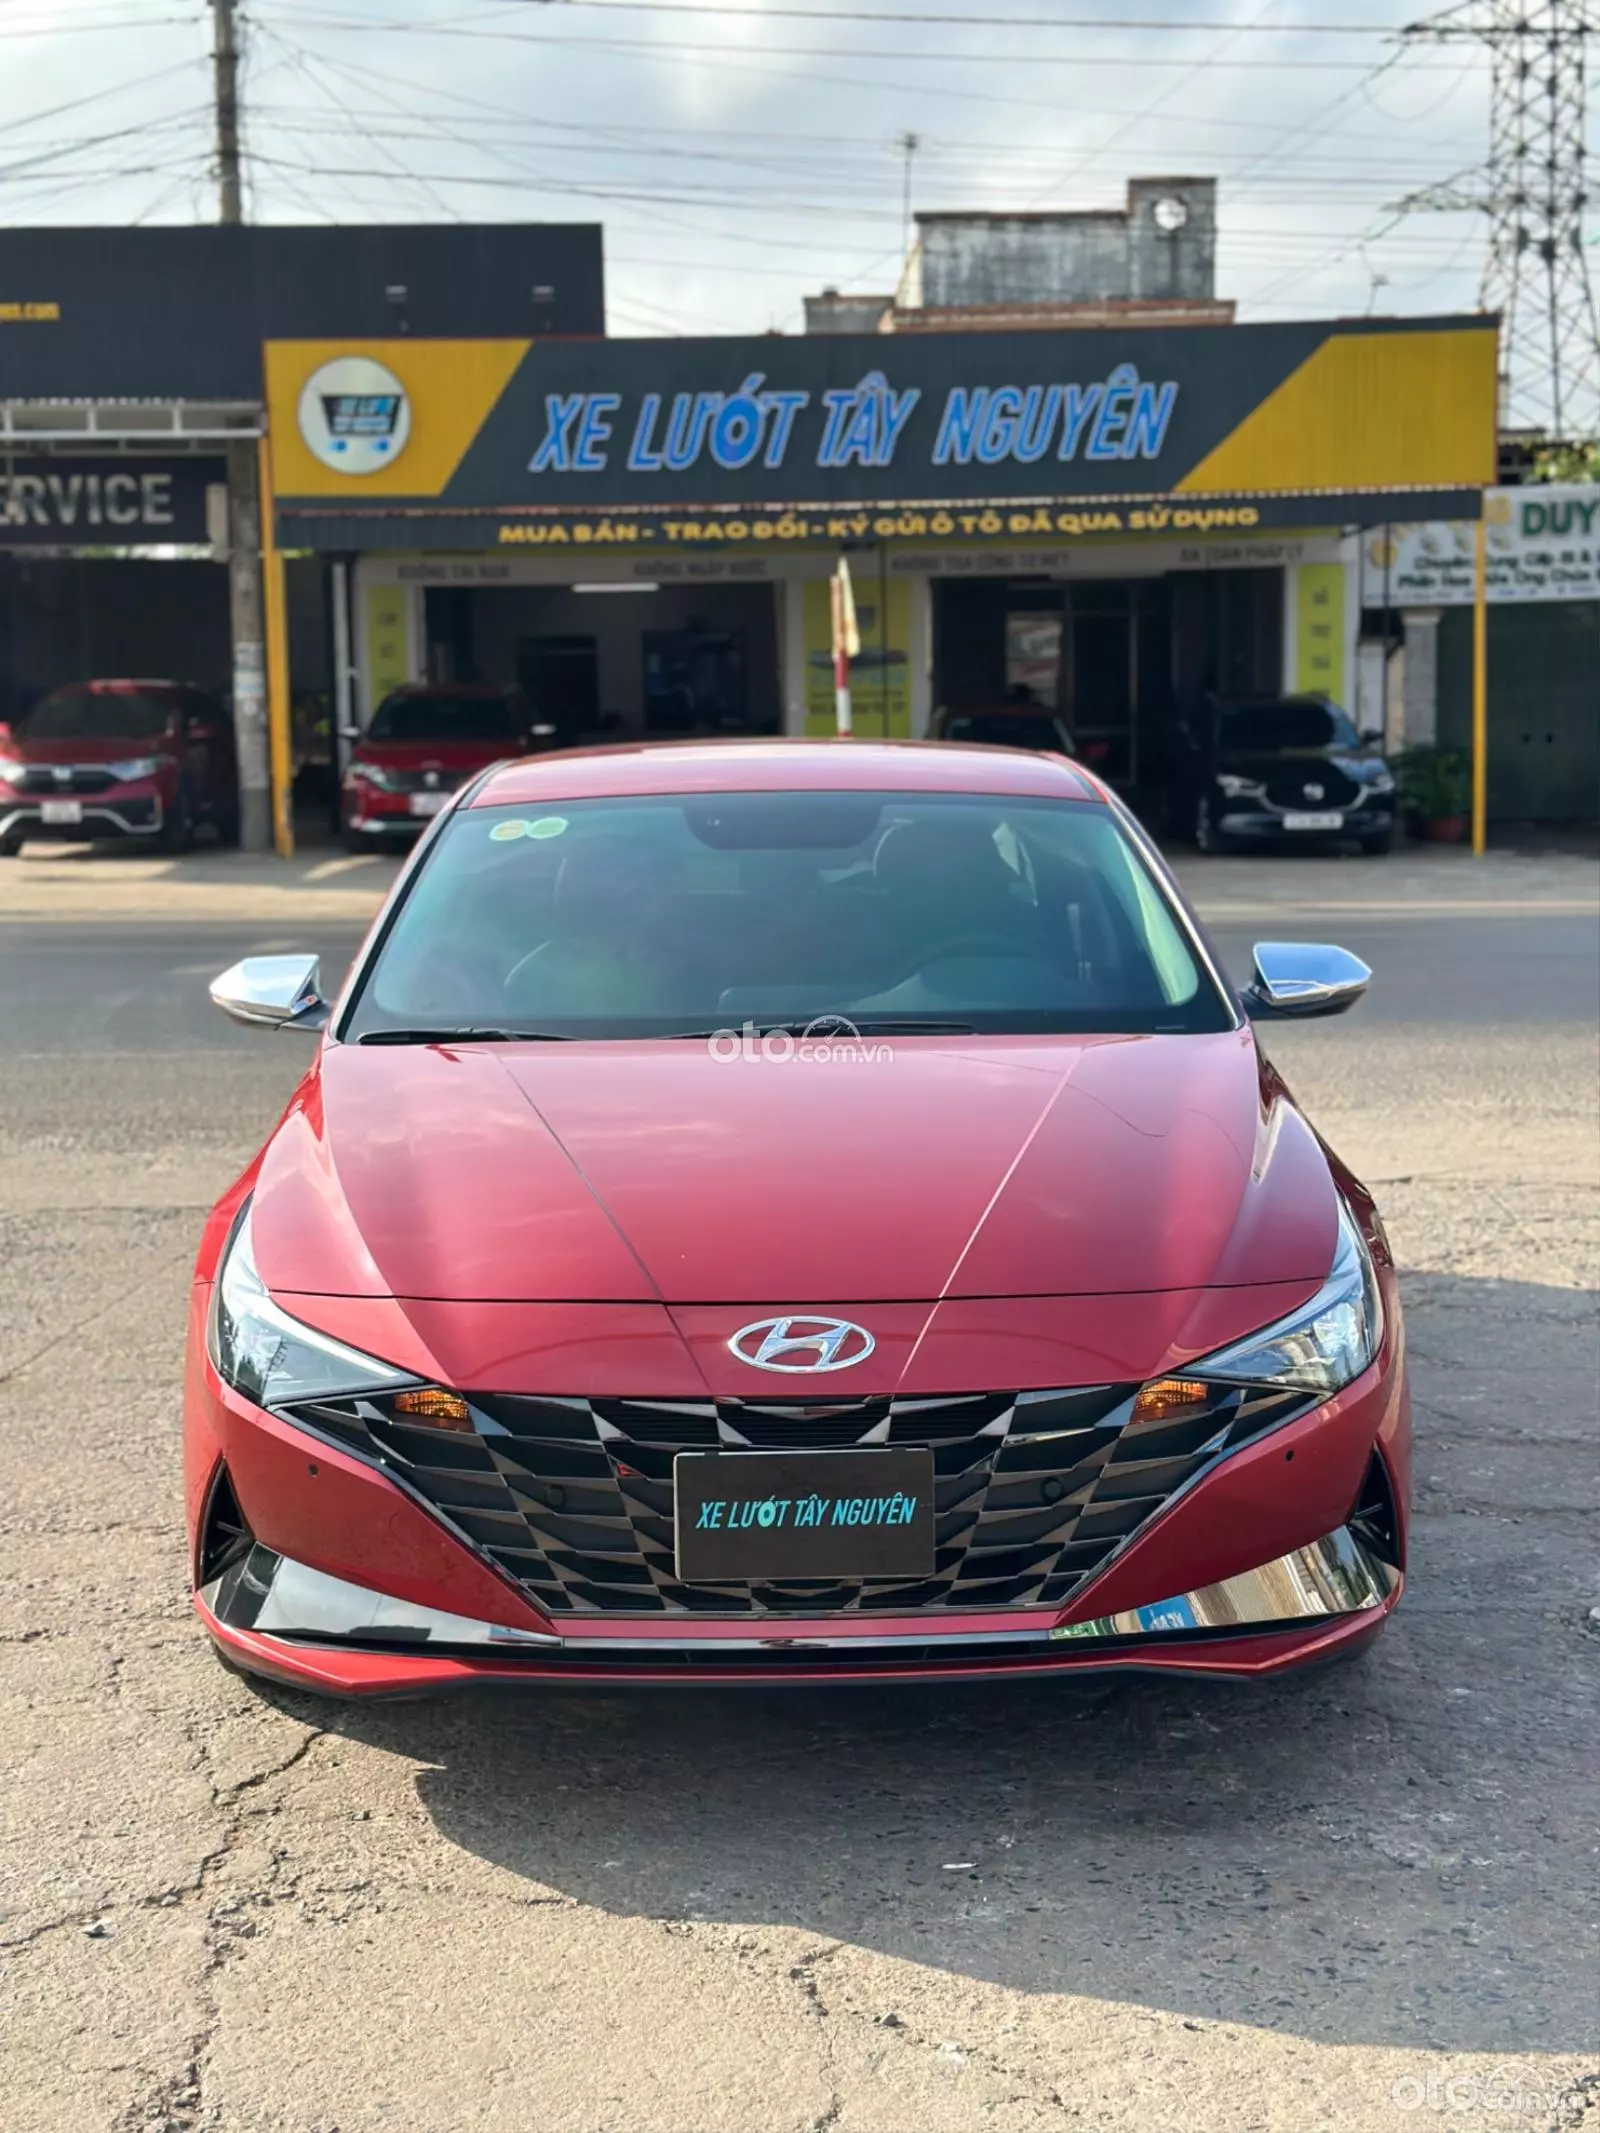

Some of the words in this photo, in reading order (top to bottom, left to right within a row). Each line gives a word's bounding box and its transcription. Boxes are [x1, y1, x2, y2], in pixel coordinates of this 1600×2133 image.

[527, 393, 621, 472] XE
[626, 372, 810, 471] LƯỚT
[816, 370, 922, 466] TÂY
[931, 363, 1179, 464] NGUYÊN
[499, 524, 569, 543] MUA
[573, 518, 637, 543] BÁN
[662, 521, 748, 542] TRAO
[828, 512, 869, 538] KÝ
[957, 508, 1002, 535] TÔ
[1008, 507, 1052, 534] ĐÃ
[1057, 511, 1122, 535] QUA
[696, 1501, 726, 1529] XE
[728, 1495, 790, 1528] LƯỚT
[793, 1493, 830, 1527] TÂY
[831, 1491, 917, 1526] NGUYÊN
